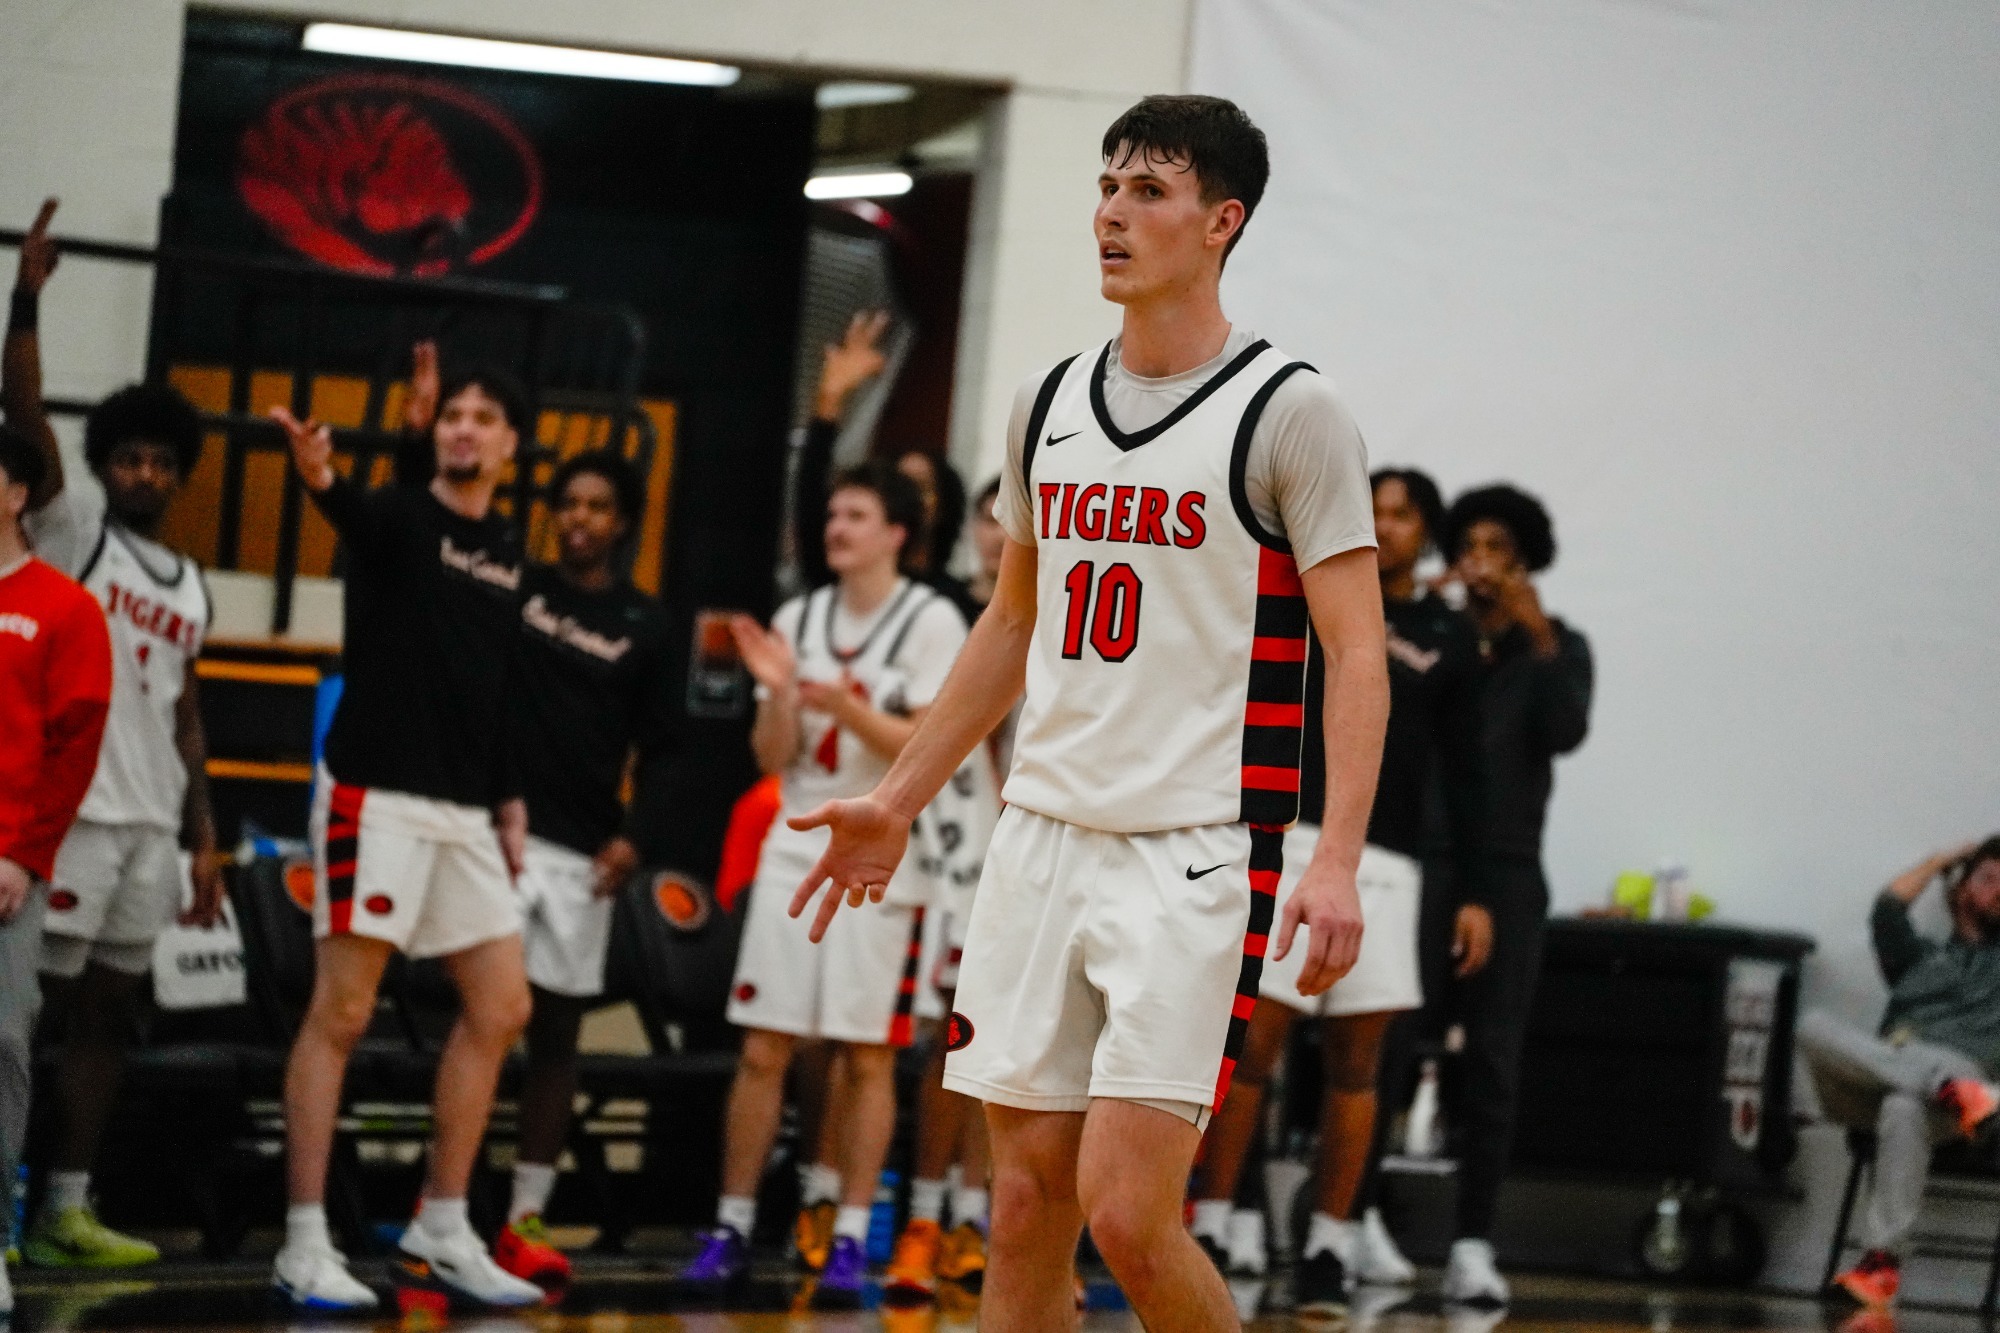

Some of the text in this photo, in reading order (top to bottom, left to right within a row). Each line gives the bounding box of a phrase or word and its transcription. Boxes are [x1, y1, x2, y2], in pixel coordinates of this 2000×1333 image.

[1039, 483, 1206, 549] TIGERS
[106, 580, 197, 650] TIGERS
[1061, 560, 1143, 663] 10
